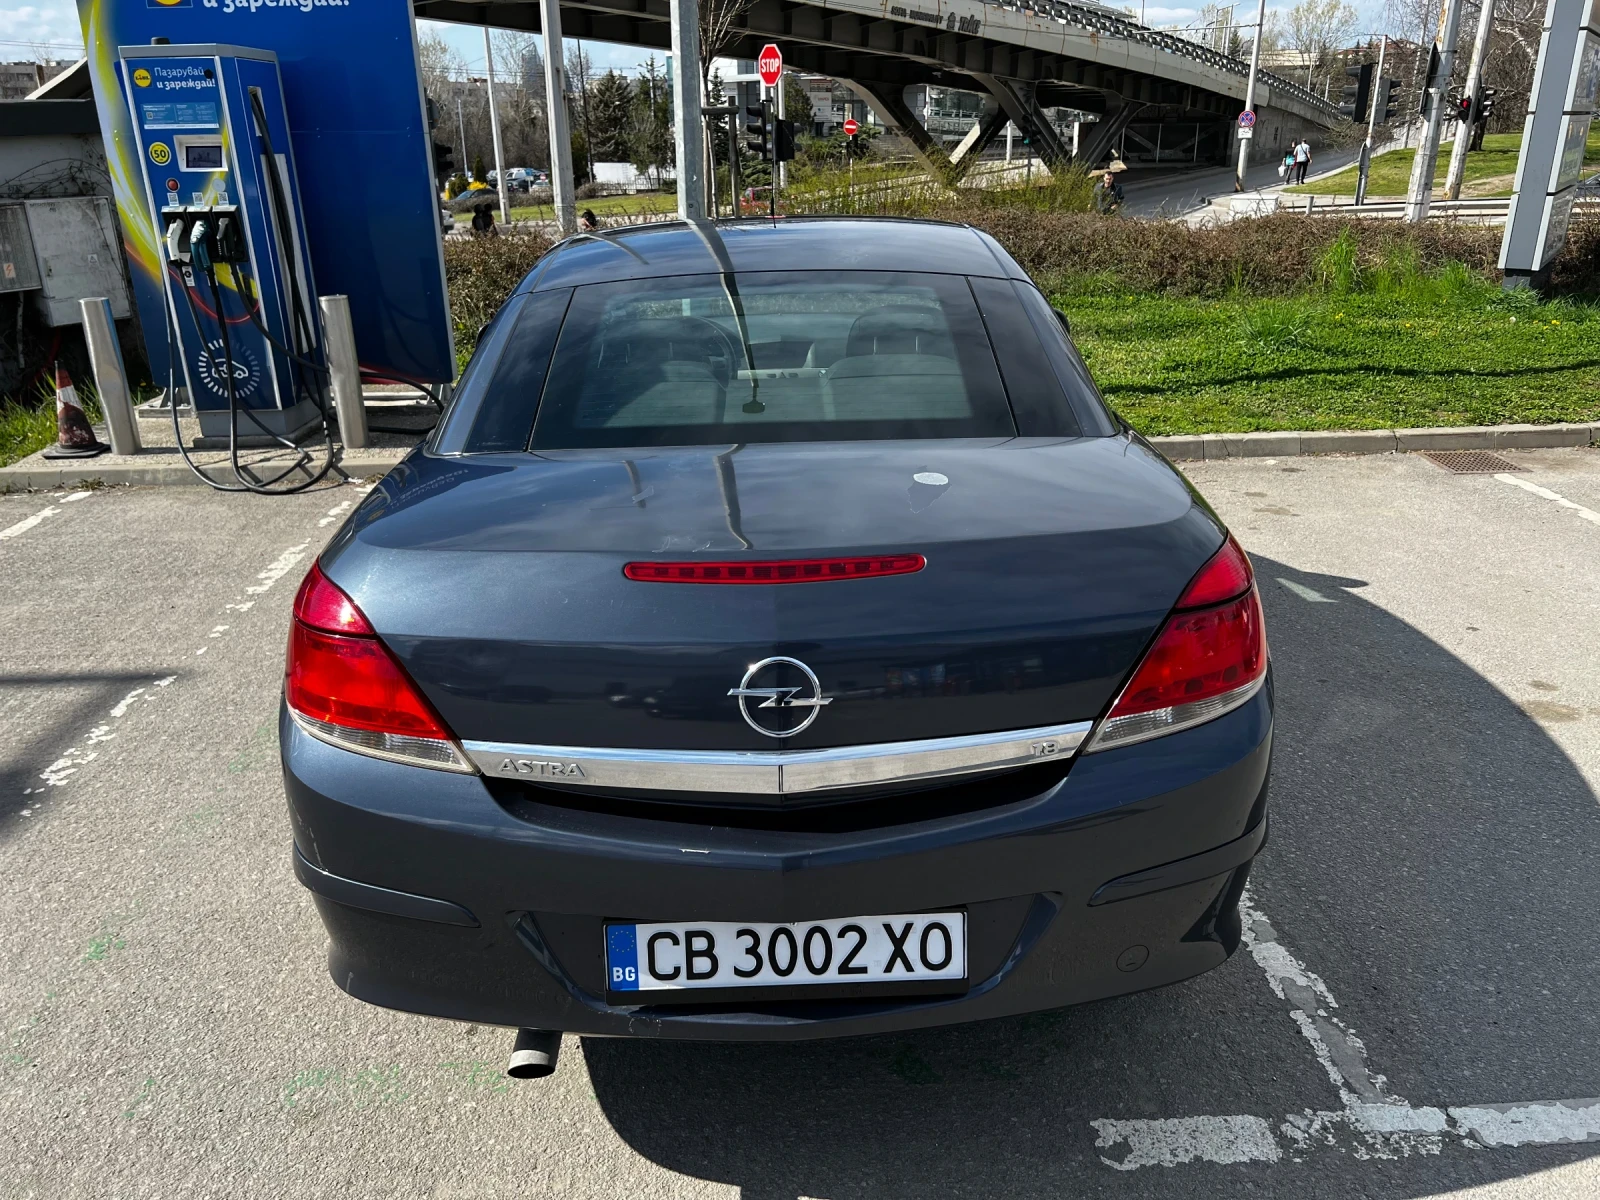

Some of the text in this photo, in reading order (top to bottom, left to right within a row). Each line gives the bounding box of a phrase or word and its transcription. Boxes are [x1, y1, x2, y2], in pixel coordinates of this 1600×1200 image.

[154, 66, 205, 79] Пазарувай
[761, 58, 780, 73] STOP
[164, 78, 216, 91] зареждай!
[153, 149, 167, 159] 50
[499, 758, 586, 778] ASTRA
[647, 922, 953, 981] CB 3002 XO
[613, 966, 636, 982] BG
